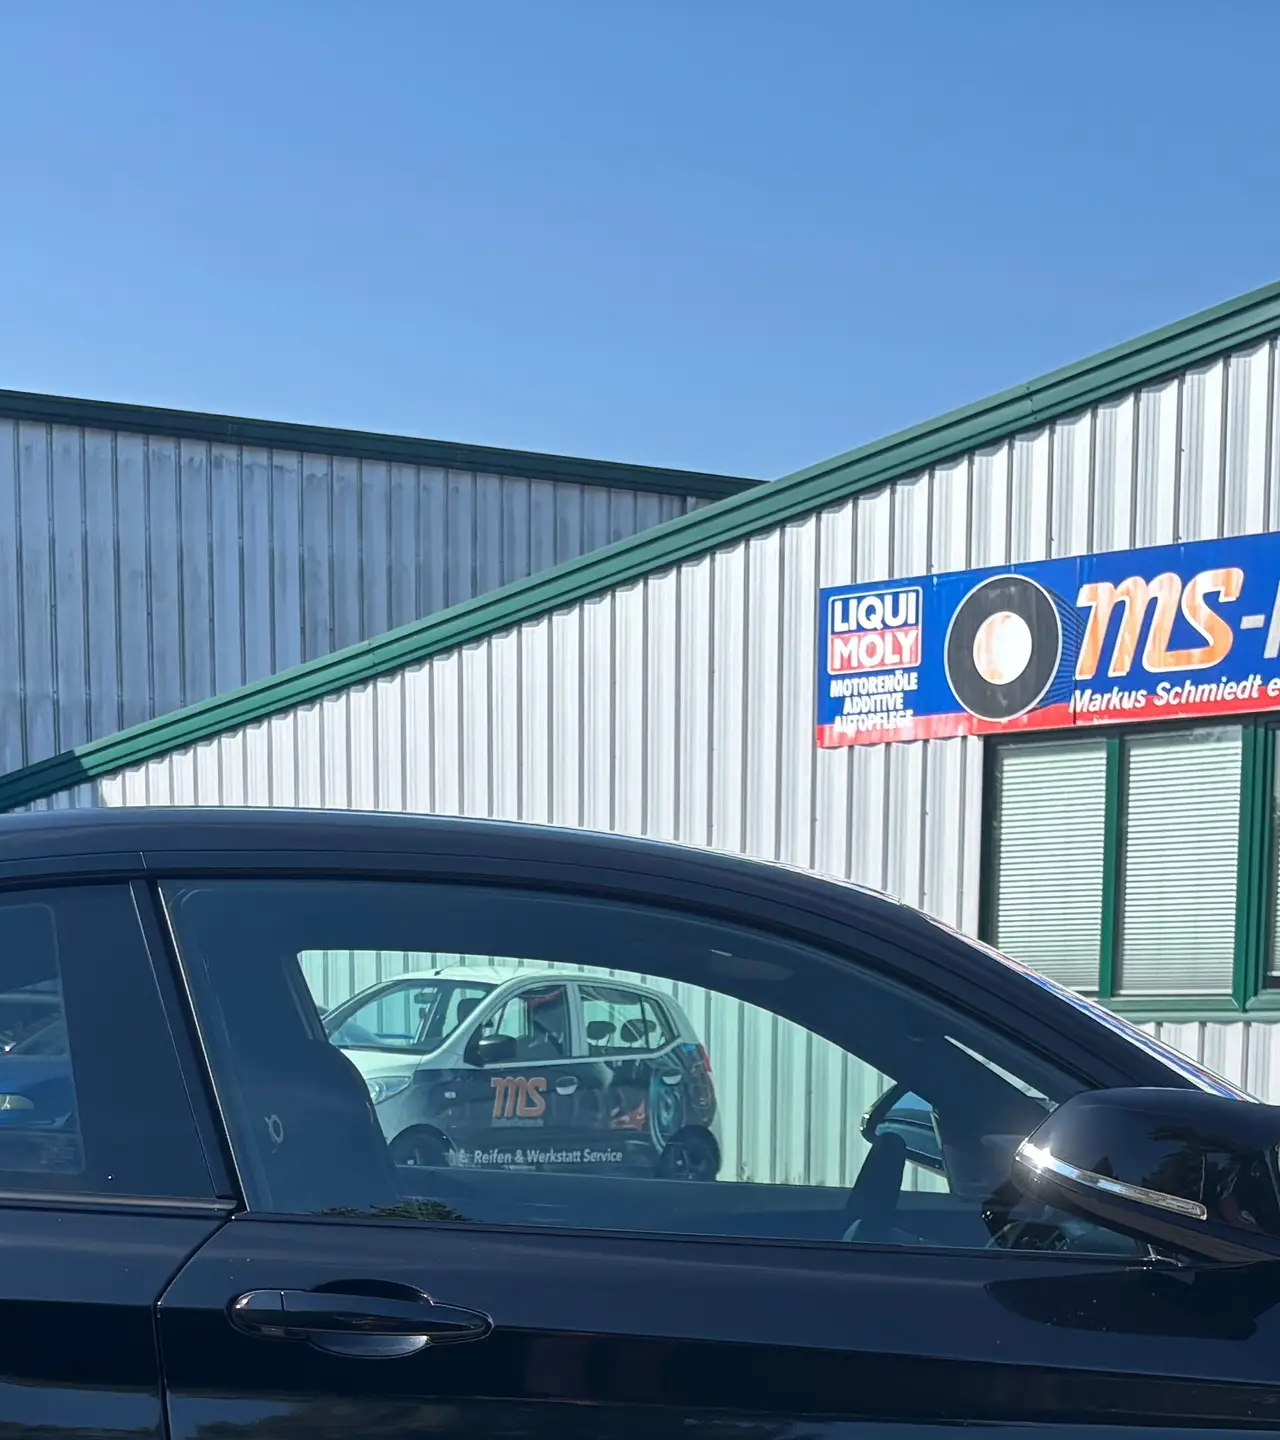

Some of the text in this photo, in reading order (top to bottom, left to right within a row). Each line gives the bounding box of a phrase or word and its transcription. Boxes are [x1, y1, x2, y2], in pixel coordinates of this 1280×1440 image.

[833, 592, 917, 632] LIQUI
[832, 629, 918, 669] MOLY
[830, 670, 918, 697] MOTORENÖLE
[1068, 686, 1147, 714] Markus
[1153, 674, 1262, 706] Schmiedt
[843, 692, 904, 715] ADDITIVE
[474, 1148, 512, 1164] Reifen
[515, 1149, 524, 1163] &
[527, 1148, 581, 1164] Werkstatt
[583, 1148, 623, 1163] Service
